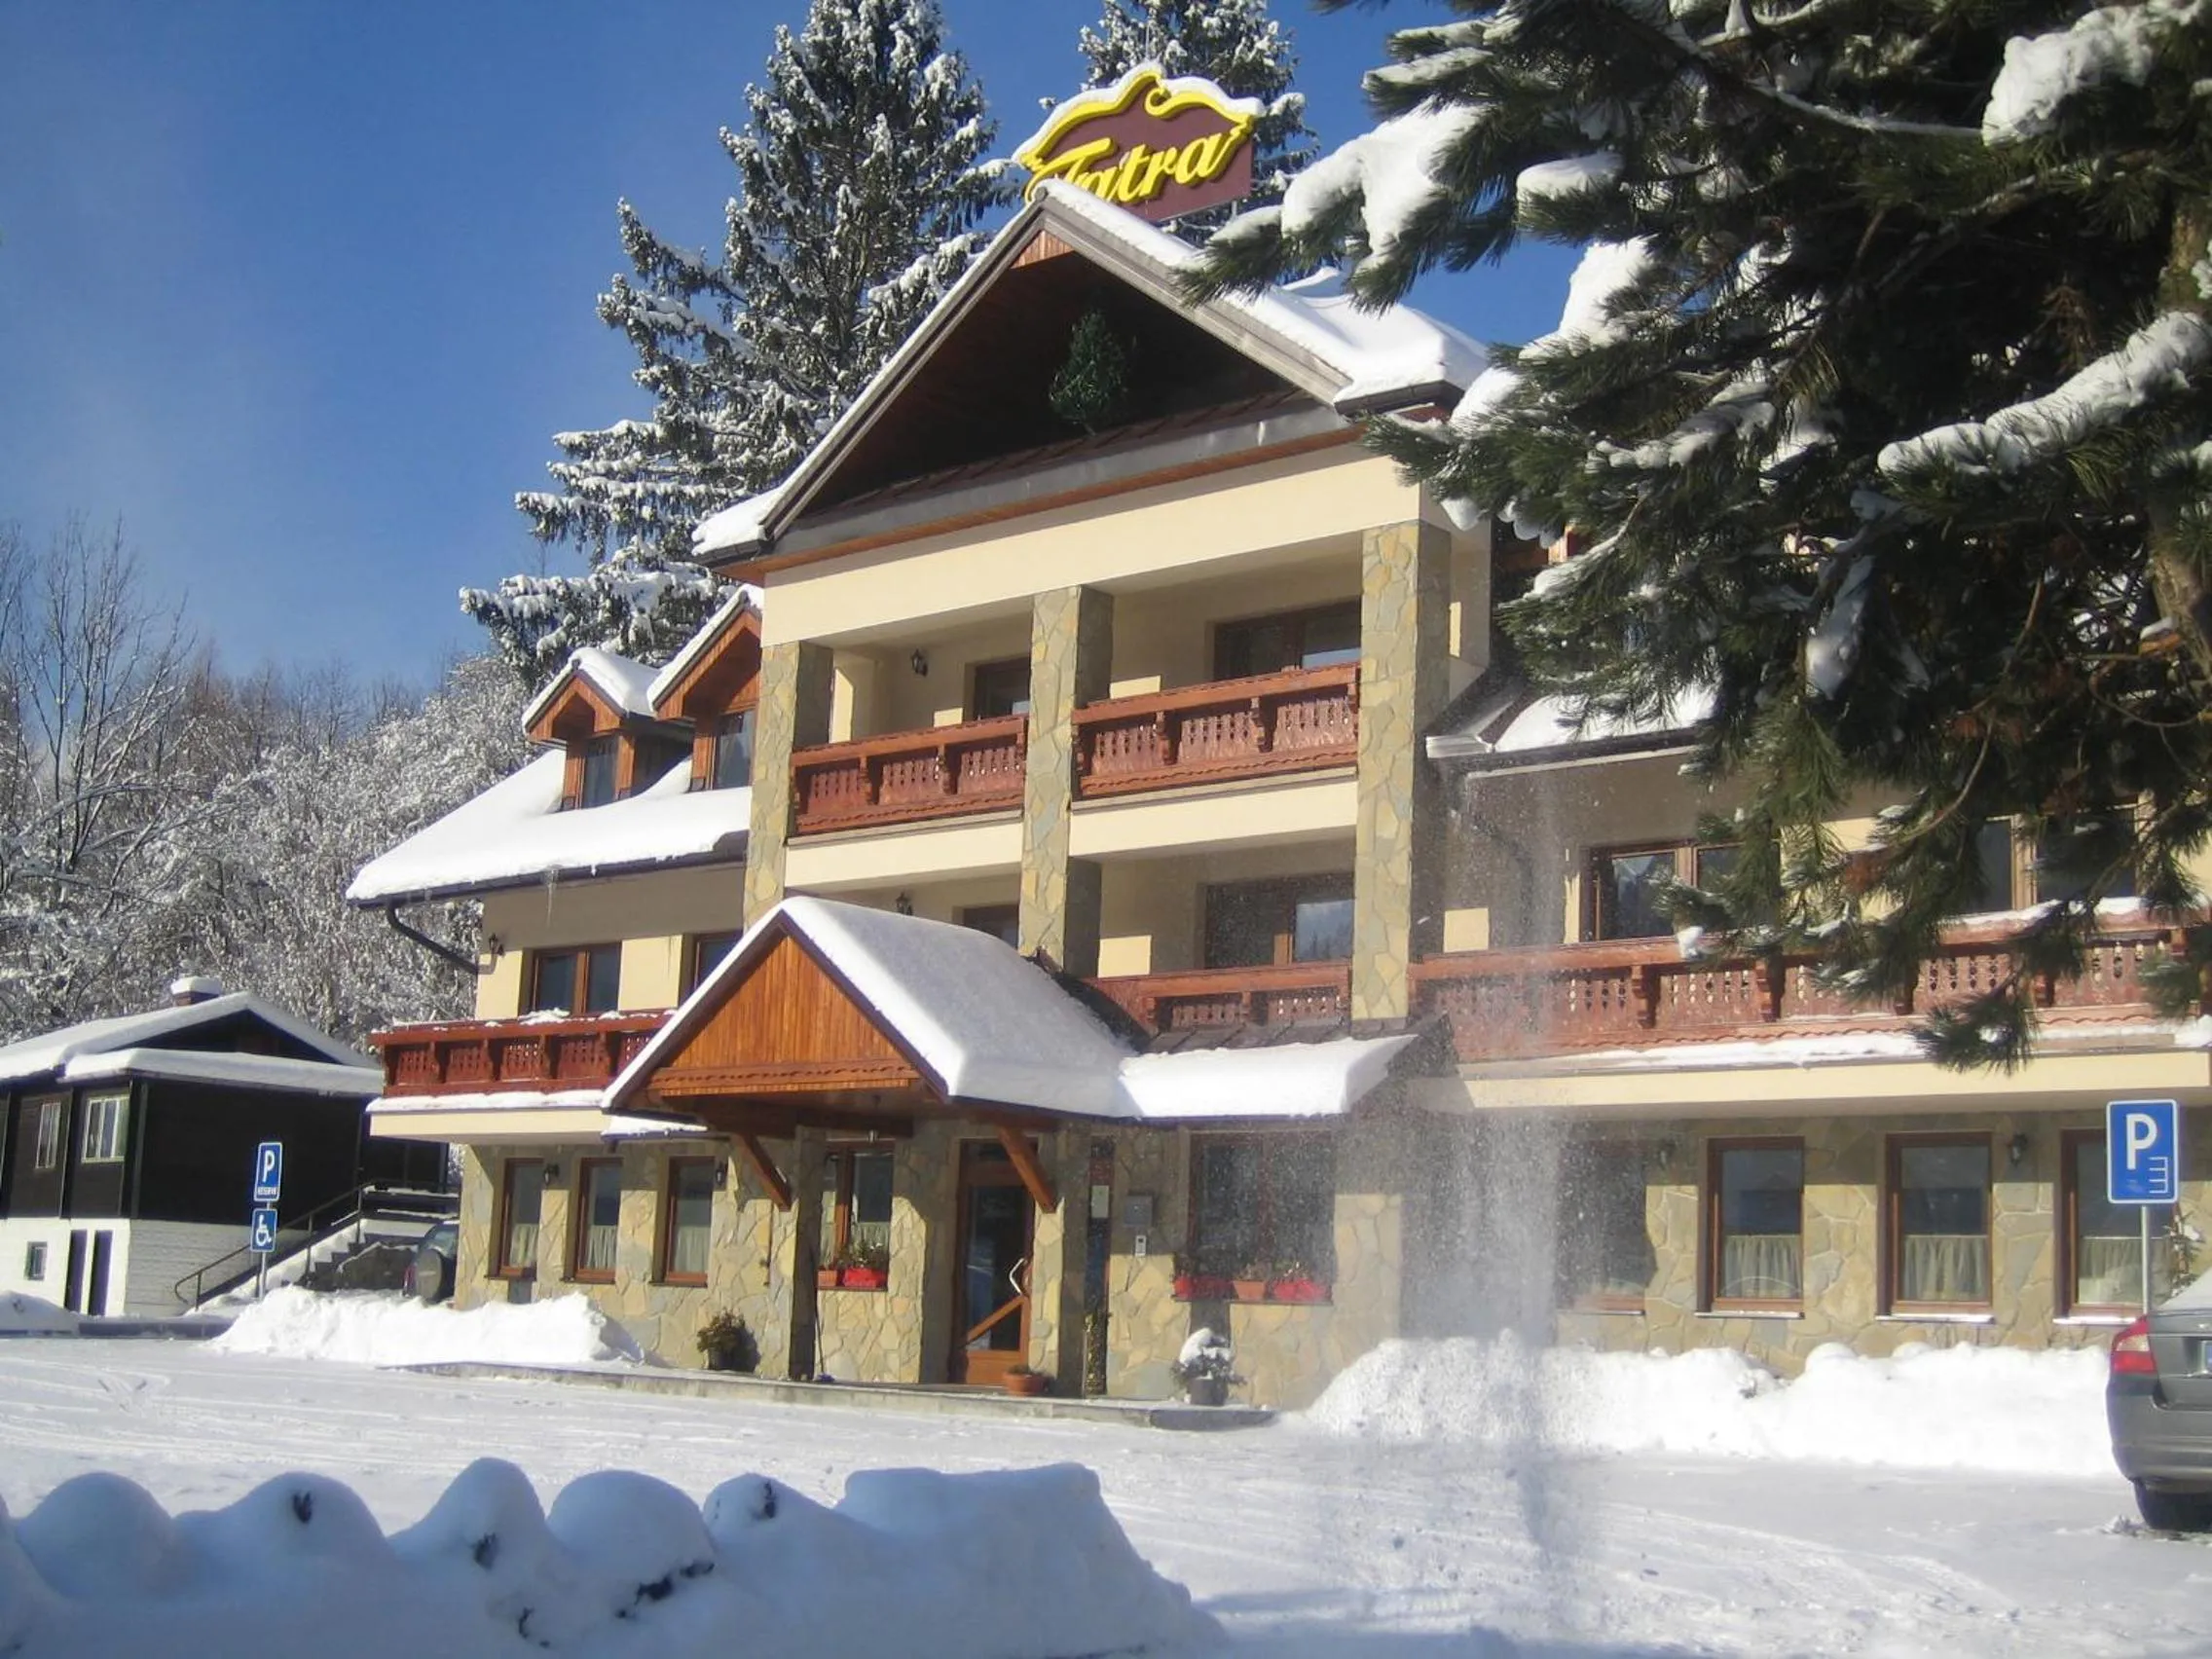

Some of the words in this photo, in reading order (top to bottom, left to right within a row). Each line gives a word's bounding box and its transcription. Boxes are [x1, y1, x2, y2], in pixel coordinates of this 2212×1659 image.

[1025, 129, 1239, 203] Tatra
[262, 1149, 276, 1183] P
[2125, 1113, 2157, 1169] P
